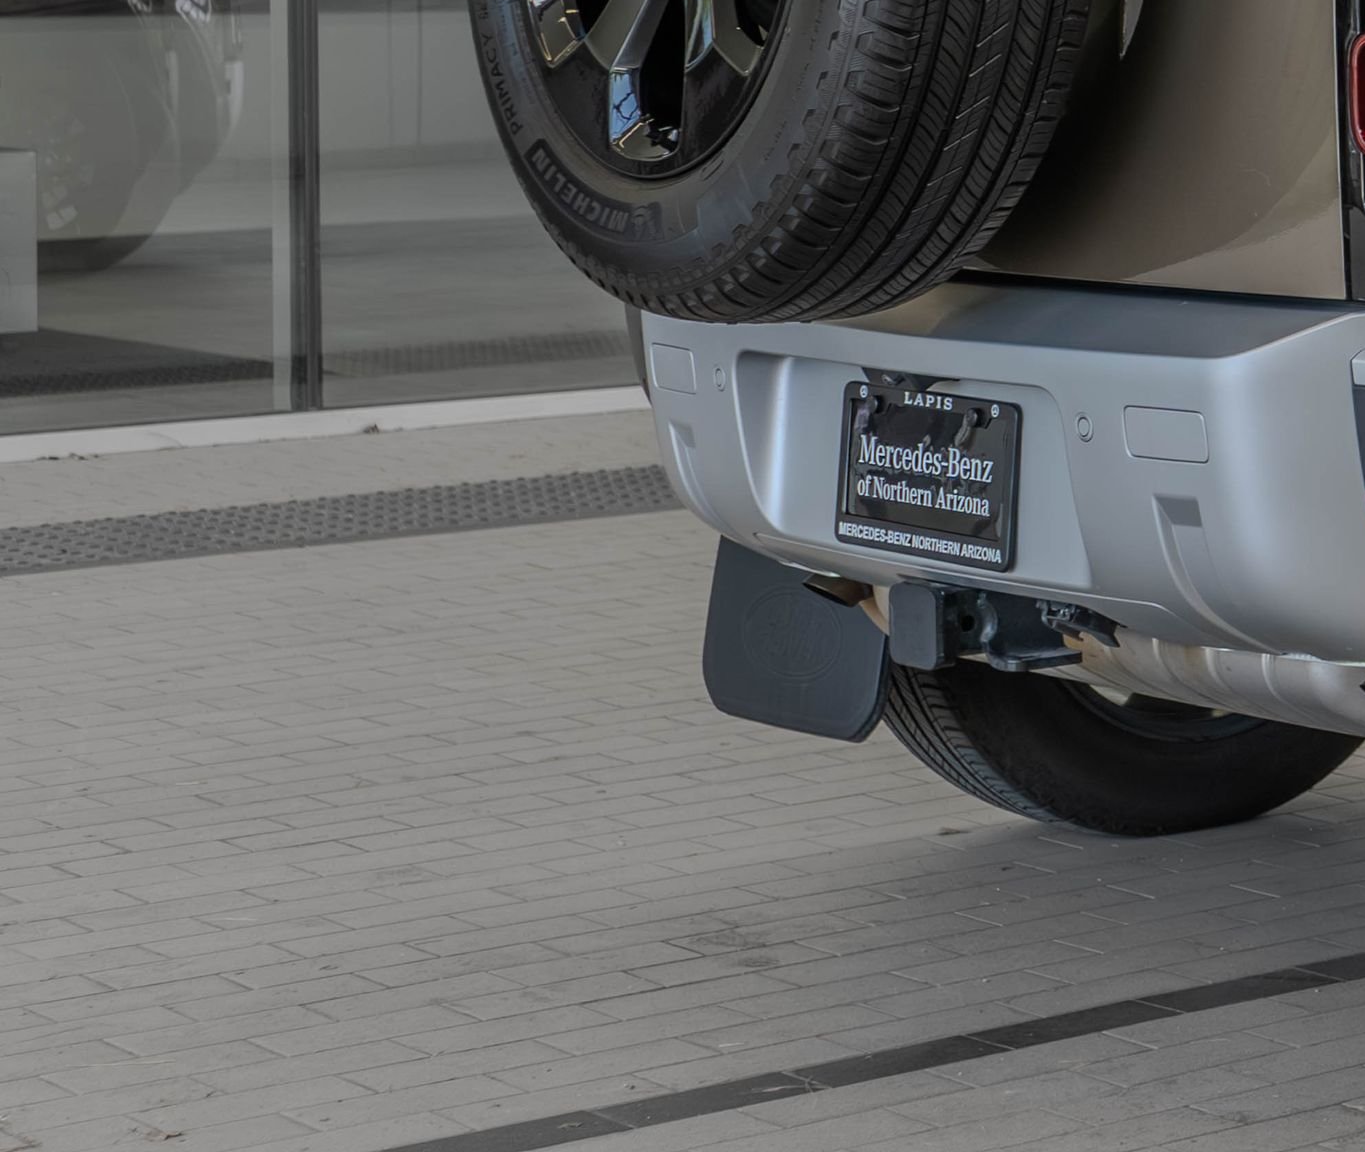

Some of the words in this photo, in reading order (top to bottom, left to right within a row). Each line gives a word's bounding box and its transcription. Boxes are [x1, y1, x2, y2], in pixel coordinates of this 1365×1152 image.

[482, 33, 523, 136] PRIMACY
[531, 148, 630, 232] MICHELIN
[904, 391, 953, 411] LAPIS
[858, 434, 993, 483] Mercedes-Benz
[857, 475, 873, 497] of
[873, 477, 933, 508] Northern
[935, 487, 990, 517] Arizona
[838, 521, 912, 548] MERCEDES-BENZ
[912, 534, 961, 556] NORTHERN
[961, 543, 1002, 564] ARIZONA
